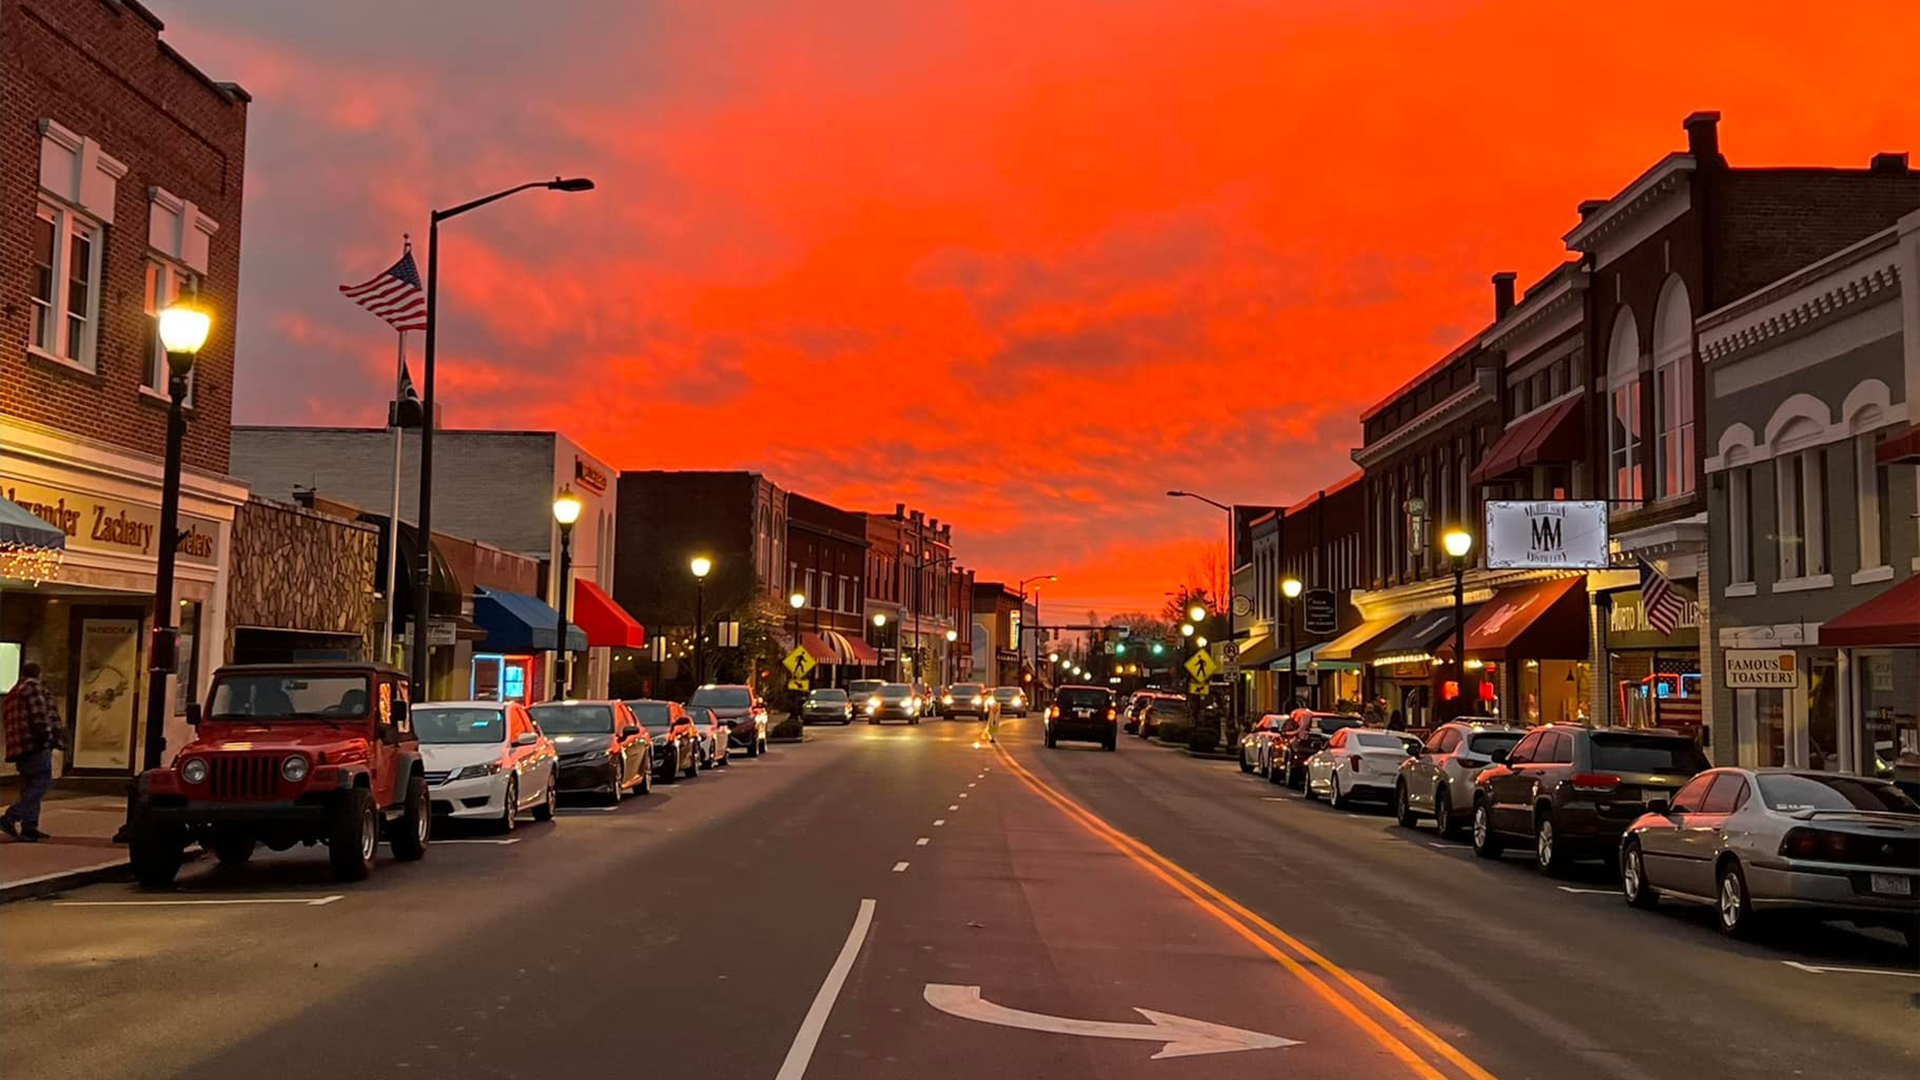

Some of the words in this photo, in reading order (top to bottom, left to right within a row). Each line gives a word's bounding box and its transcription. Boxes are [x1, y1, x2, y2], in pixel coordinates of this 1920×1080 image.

[91, 504, 153, 554] Zachary
[1727, 659, 1779, 670] FAMOUS
[1731, 672, 1794, 684] TOASTERY
